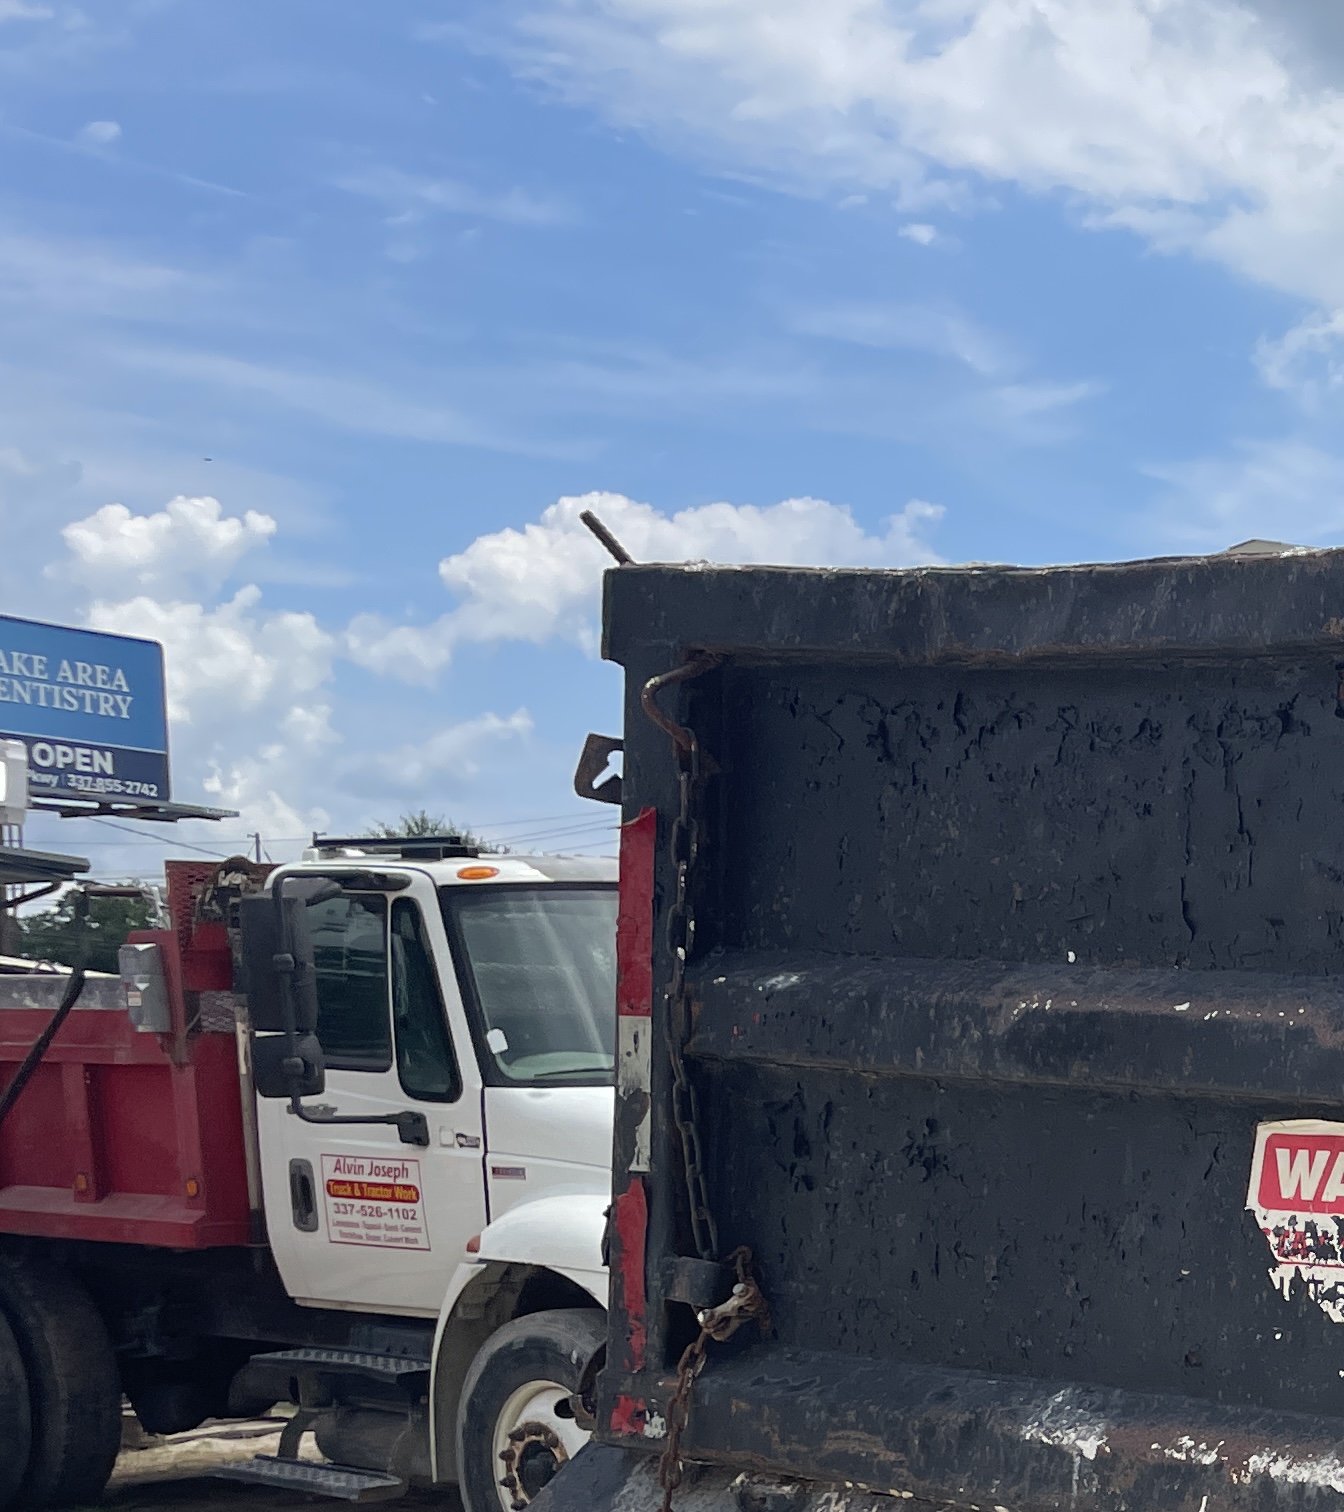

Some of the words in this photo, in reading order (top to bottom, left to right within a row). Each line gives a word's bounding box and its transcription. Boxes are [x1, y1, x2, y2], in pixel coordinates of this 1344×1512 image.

[0, 649, 48, 680] AKE
[56, 659, 130, 692] AREA
[0, 677, 133, 719] ENTISTRY
[32, 742, 115, 775] OPEN
[333, 1157, 364, 1176] Alvin
[367, 1160, 409, 1183] Joseph
[333, 1202, 418, 1221] 337-526-1102
